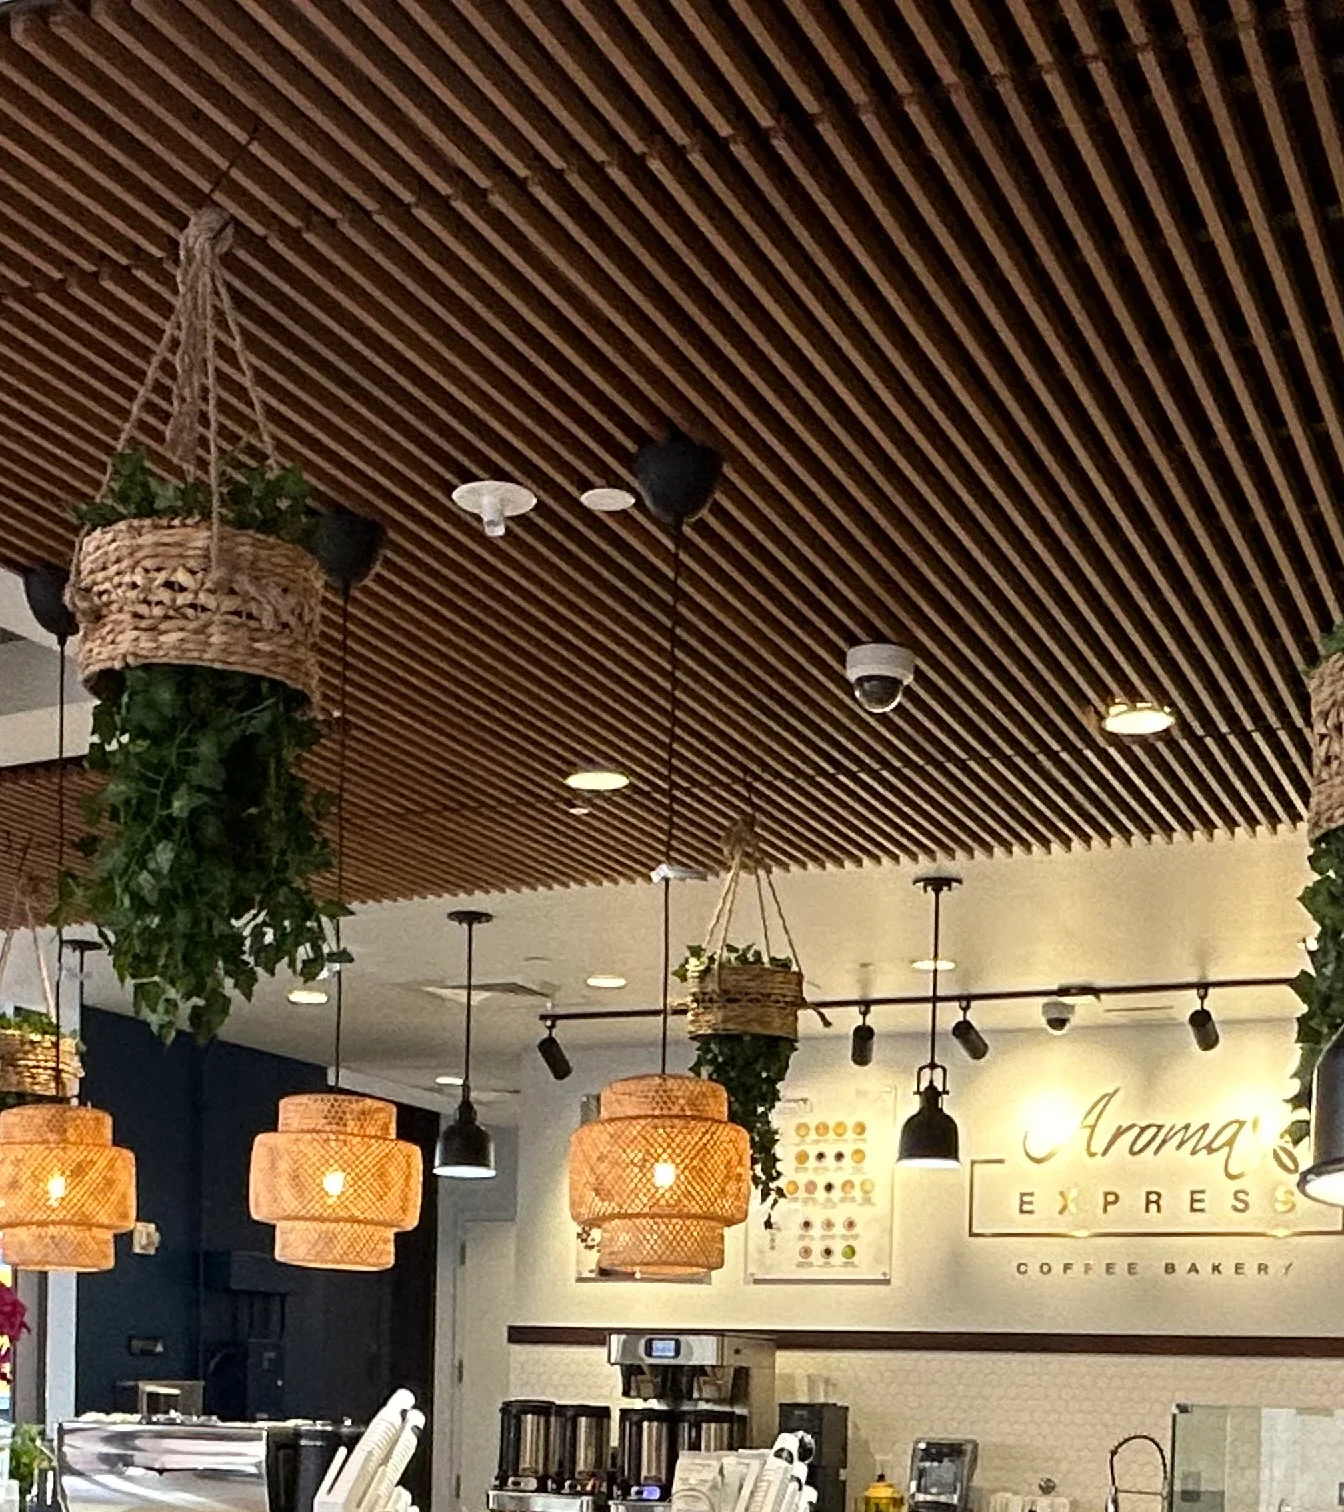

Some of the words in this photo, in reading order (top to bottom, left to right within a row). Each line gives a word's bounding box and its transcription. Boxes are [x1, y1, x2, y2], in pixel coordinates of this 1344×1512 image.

[1023, 1087, 1269, 1180] Aroma'
[1018, 1188, 1298, 1216] EXPRESS
[1016, 1262, 1138, 1276] COFFEE
